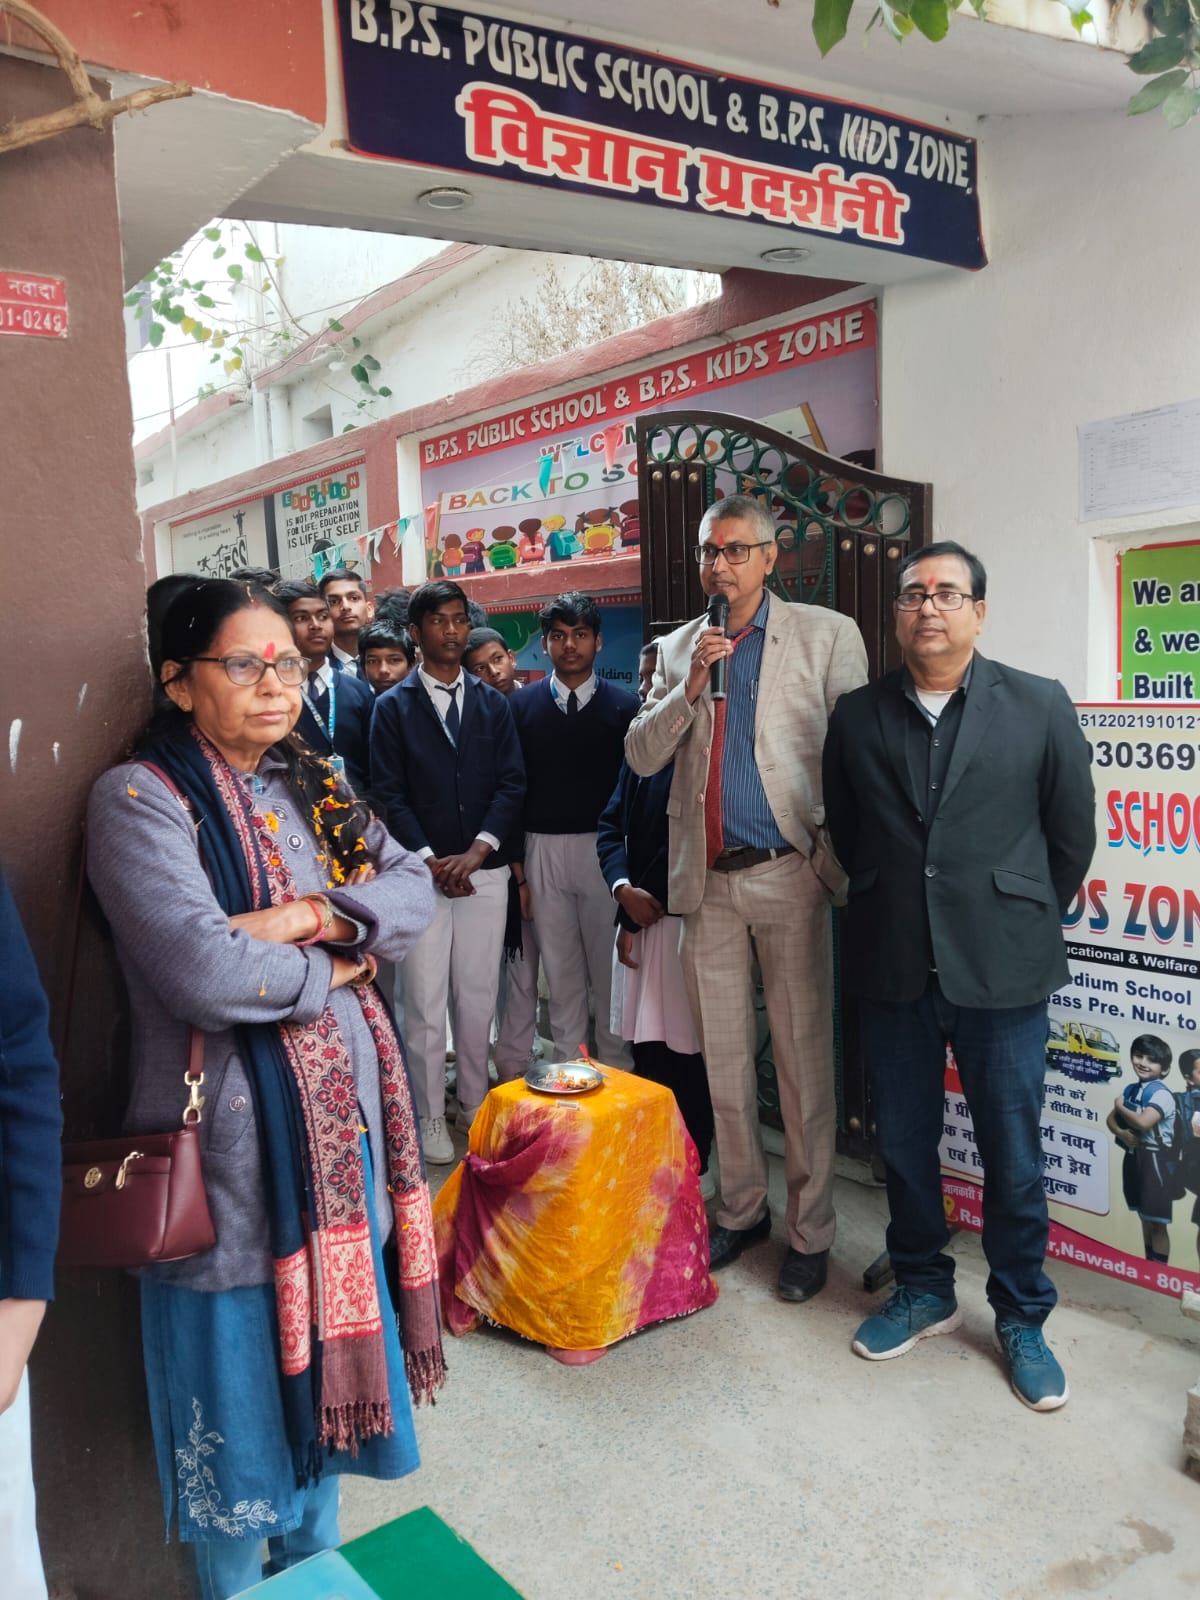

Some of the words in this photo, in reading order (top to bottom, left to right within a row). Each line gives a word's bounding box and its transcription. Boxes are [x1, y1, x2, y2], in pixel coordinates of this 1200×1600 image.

[351, 0, 450, 59] B.P.S.
[462, 16, 587, 93] PUBLIC
[595, 52, 717, 126] SCHOOL
[726, 93, 748, 133] &
[759, 94, 829, 154] B.P.S.
[839, 113, 900, 170] KIDS
[905, 130, 969, 188] ZONE
[458, 83, 690, 201] विज्ञान
[698, 150, 907, 243] प्रदर्शनी
[425, 440, 462, 464] B.P.S.
[467, 416, 525, 451] PUBLIC
[531, 391, 607, 433] SCHOOL
[613, 387, 631, 409] &
[639, 365, 697, 403] B.P.S.
[706, 340, 769, 383] KIDS
[777, 311, 864, 363] ZONE
[283, 473, 358, 510] EDUCATION
[447, 481, 533, 511] BACK
[547, 472, 589, 495] TO
[286, 518, 293, 527] IS
[295, 514, 307, 525] NOT
[310, 499, 359, 520] PREPARATION
[320, 510, 360, 528] EDUCATION
[288, 537, 298, 549] IS
[300, 531, 319, 546] LIFE
[323, 528, 332, 539] IT
[336, 521, 360, 537] SELF
[1133, 579, 1172, 605] We
[1180, 582, 1200, 602] a
[1134, 628, 1152, 653] &
[1134, 674, 1193, 699] Built
[1128, 953, 1139, 965] &
[1143, 955, 1198, 974] Welfare
[1072, 972, 1118, 993] dium
[1125, 980, 1191, 1006] School
[1088, 997, 1125, 1018] Pre.
[1132, 1005, 1170, 1026] Nur.
[1177, 1013, 1197, 1031] to
[1046, 1240, 1138, 1280] r,Nawada
